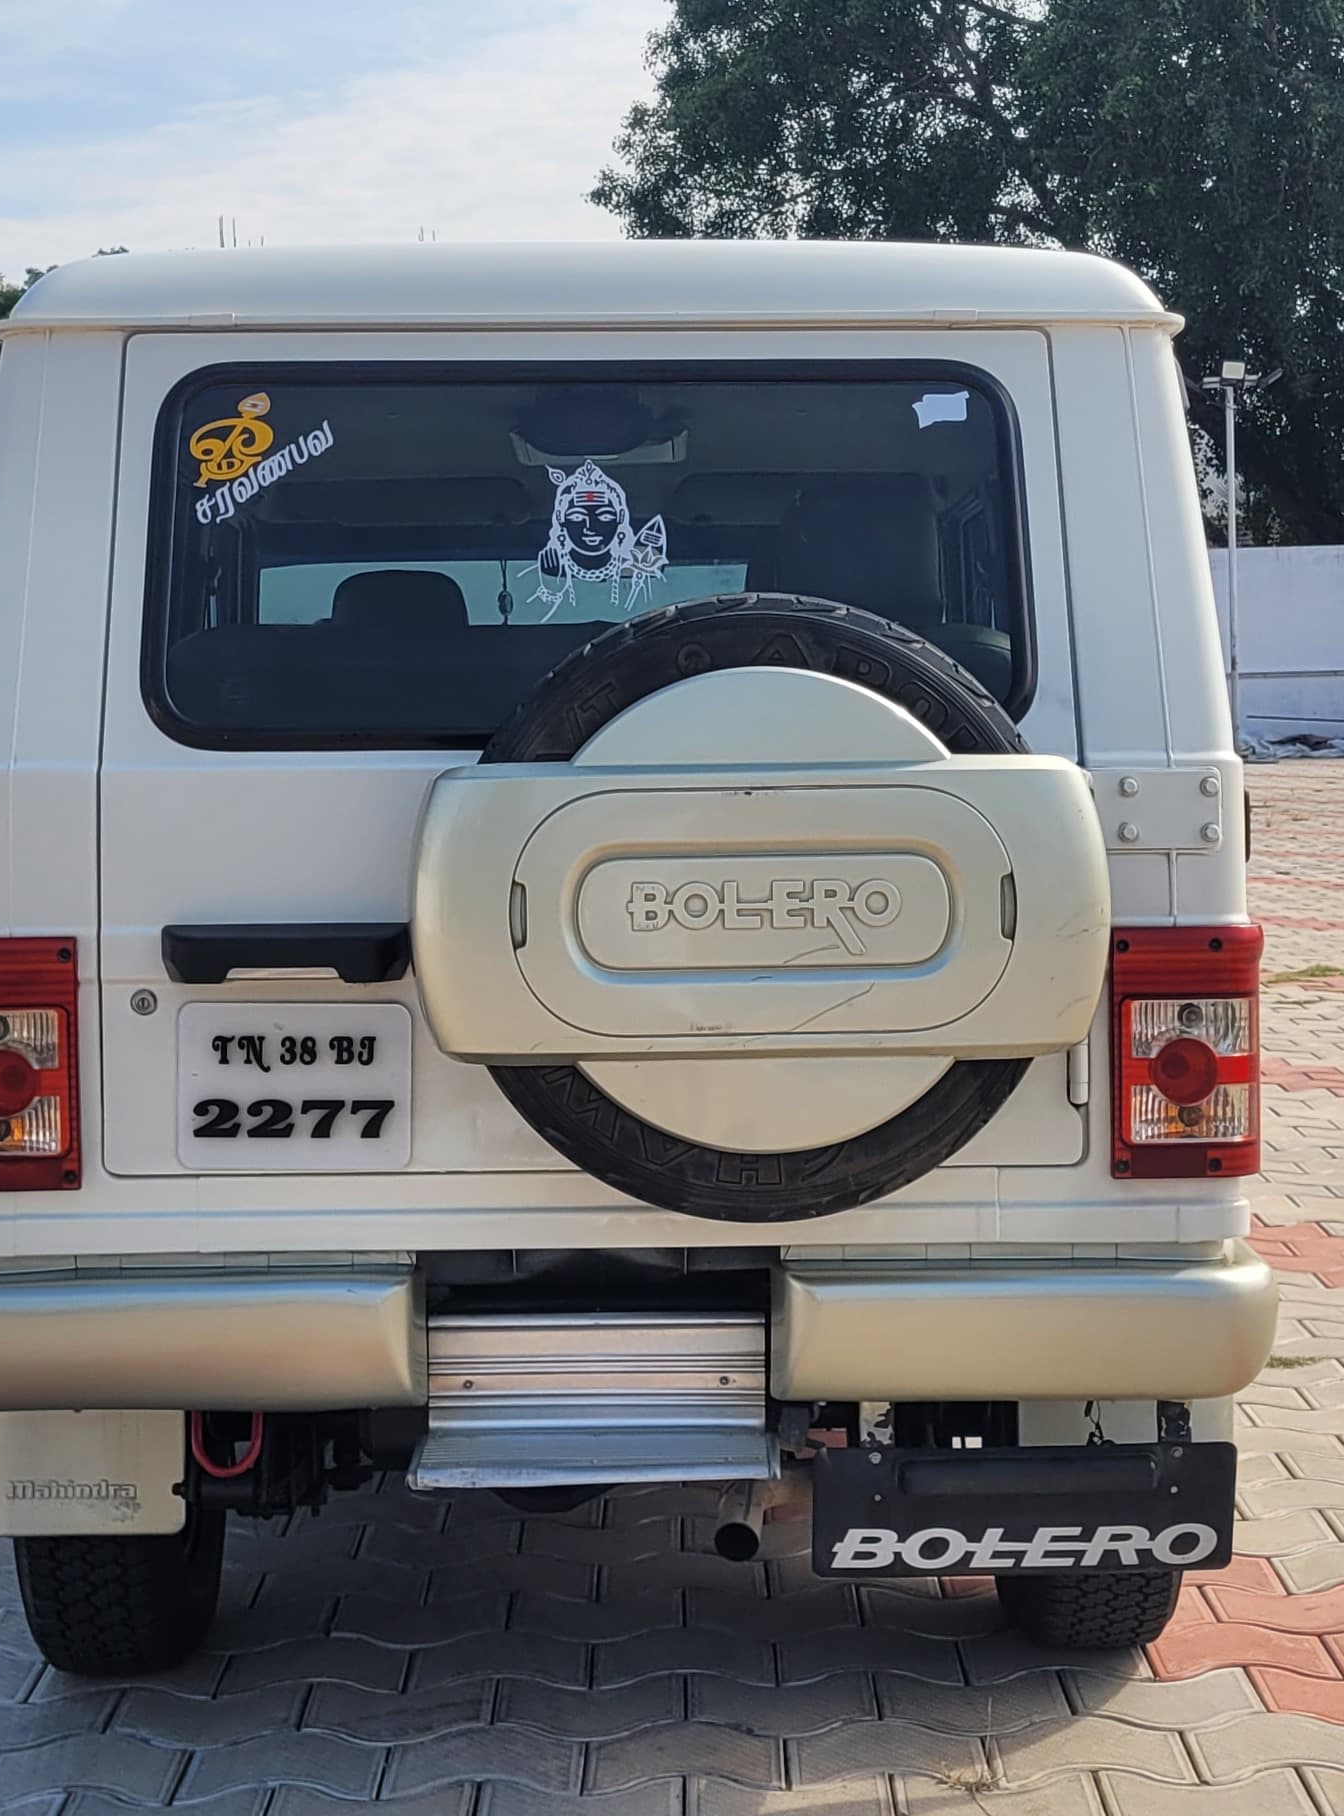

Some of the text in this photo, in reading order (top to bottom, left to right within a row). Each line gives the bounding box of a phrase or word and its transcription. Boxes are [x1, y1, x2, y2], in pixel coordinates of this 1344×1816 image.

[626, 878, 902, 955] BOLERO
[212, 1035, 376, 1073] TN 38 BJ
[193, 1099, 395, 1138] 2277
[6, 1478, 139, 1501] Mahindra
[830, 1523, 1218, 1569] BOLERO
